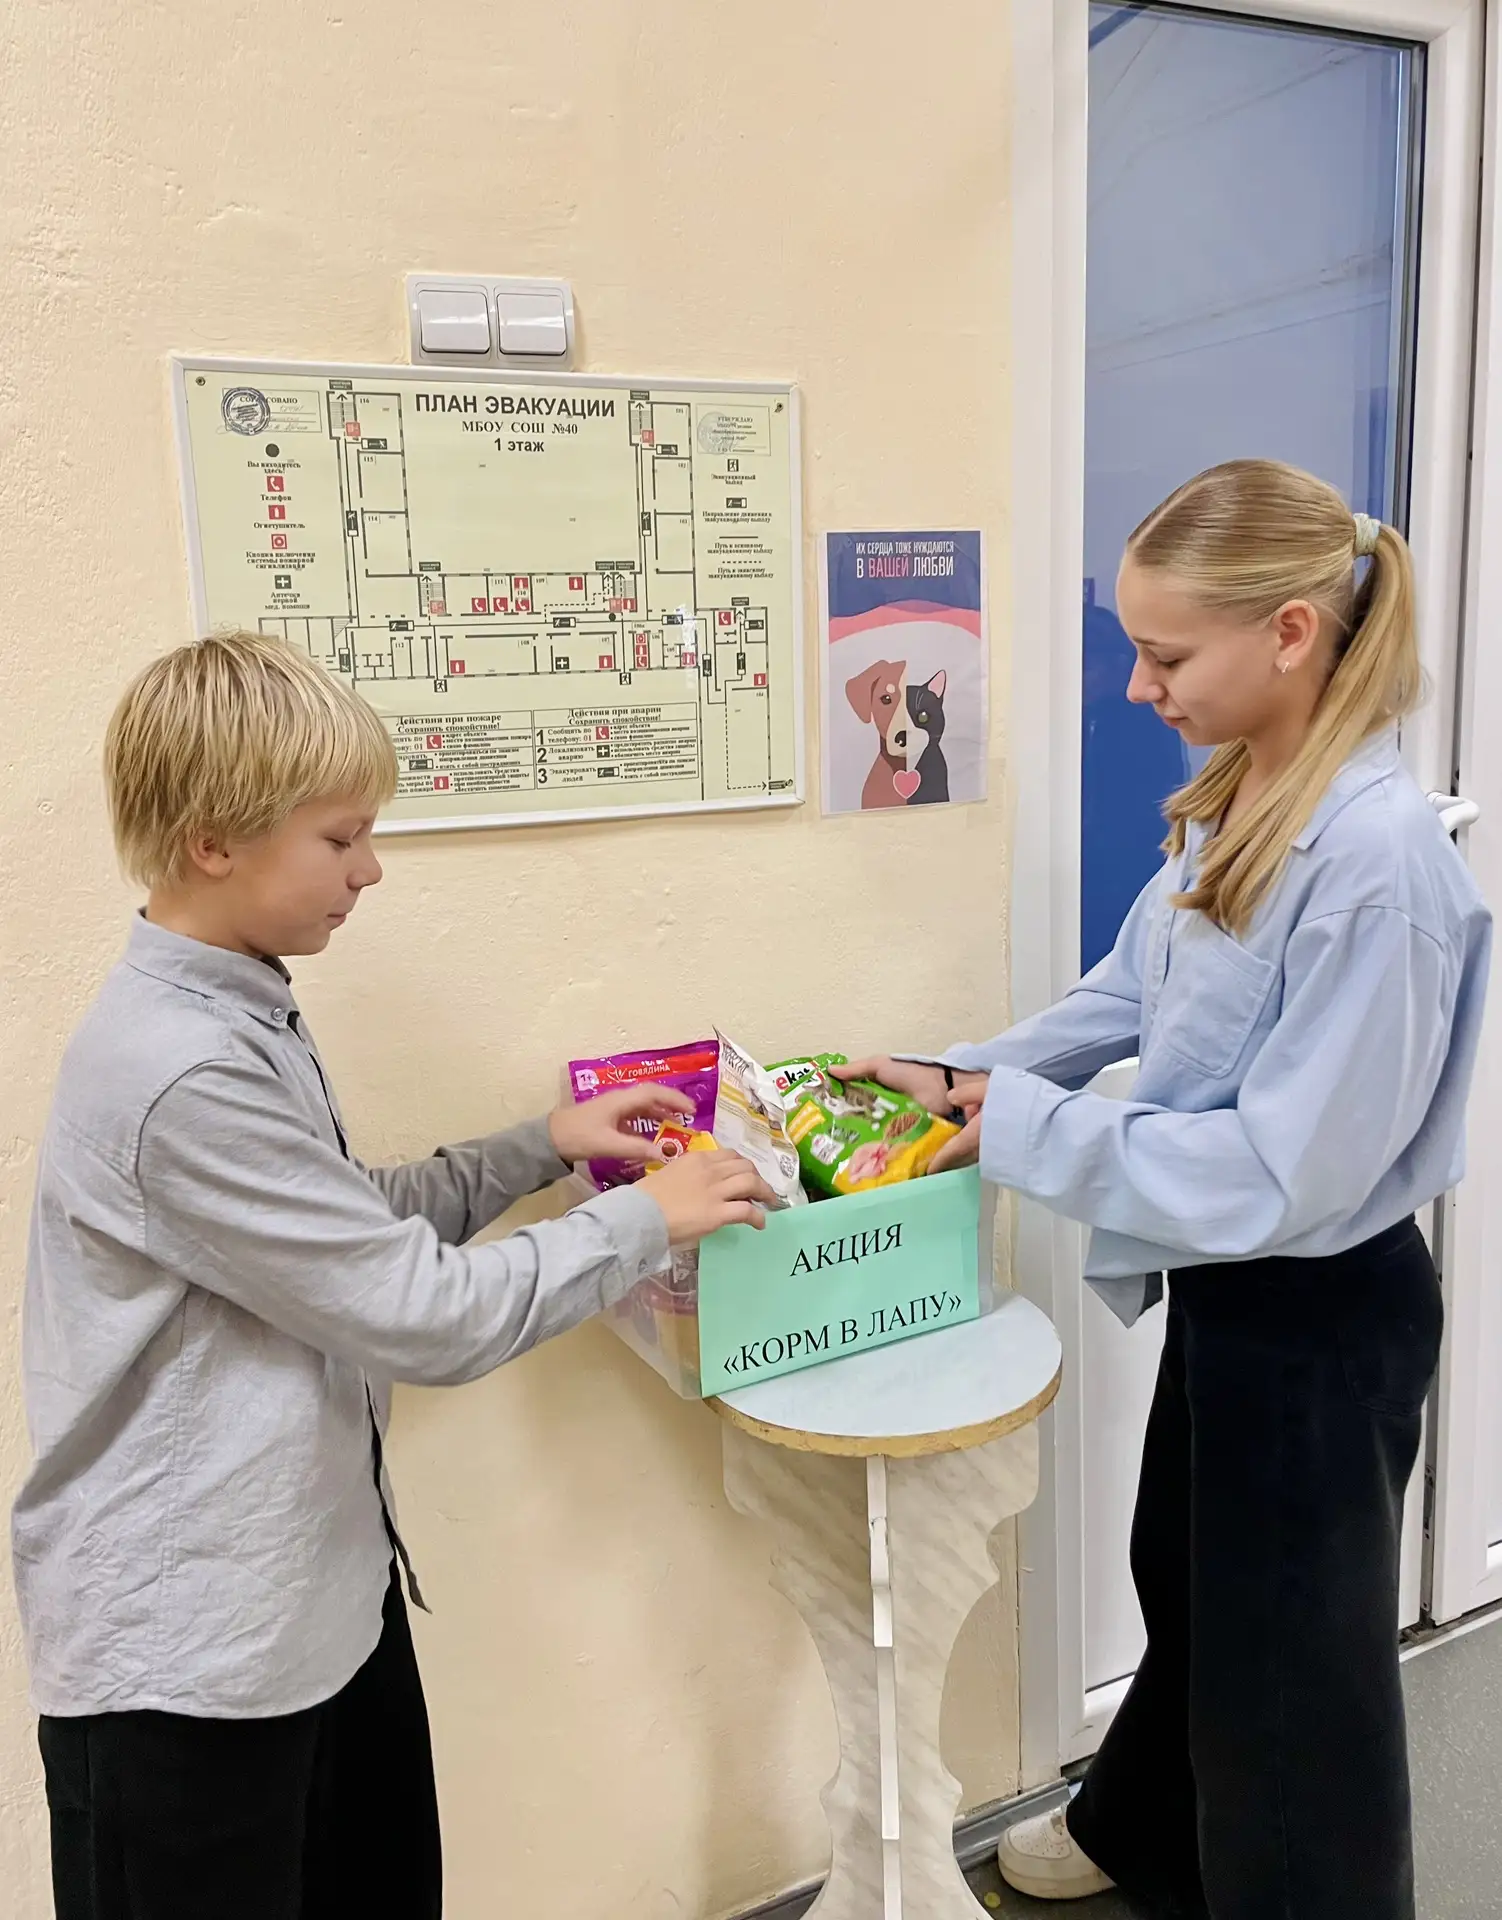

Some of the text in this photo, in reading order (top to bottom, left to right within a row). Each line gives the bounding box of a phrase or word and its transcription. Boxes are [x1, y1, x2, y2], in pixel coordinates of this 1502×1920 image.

[416, 394, 615, 419] ПЛАН ЭВАКУАЦИИ
[462, 421, 578, 435] МБОУ СОШ №40
[494, 438, 545, 452] 1 этаж
[260, 494, 292, 503] Телефон
[254, 522, 305, 530] Огнетушитель
[856, 541, 954, 556] ИХ СЕРДЦА ТОЖЕ НУЖДАЮТСЯ
[856, 554, 954, 578] В ВАШЕЙ ЛЮБВИ
[568, 707, 661, 718] Действия при аварии
[396, 715, 501, 726] Действия при пожаре
[569, 718, 610, 726] Сохранить
[398, 722, 500, 734] Сохранить спокойствие!
[536, 729, 544, 745] 1
[537, 748, 547, 763] 2
[538, 768, 547, 783] 3
[628, 1064, 671, 1077] ГОВЯДИНА
[790, 1222, 904, 1277] АКЦИЯ
[723, 1291, 962, 1375] «КОРМ В ЛАПУ»
